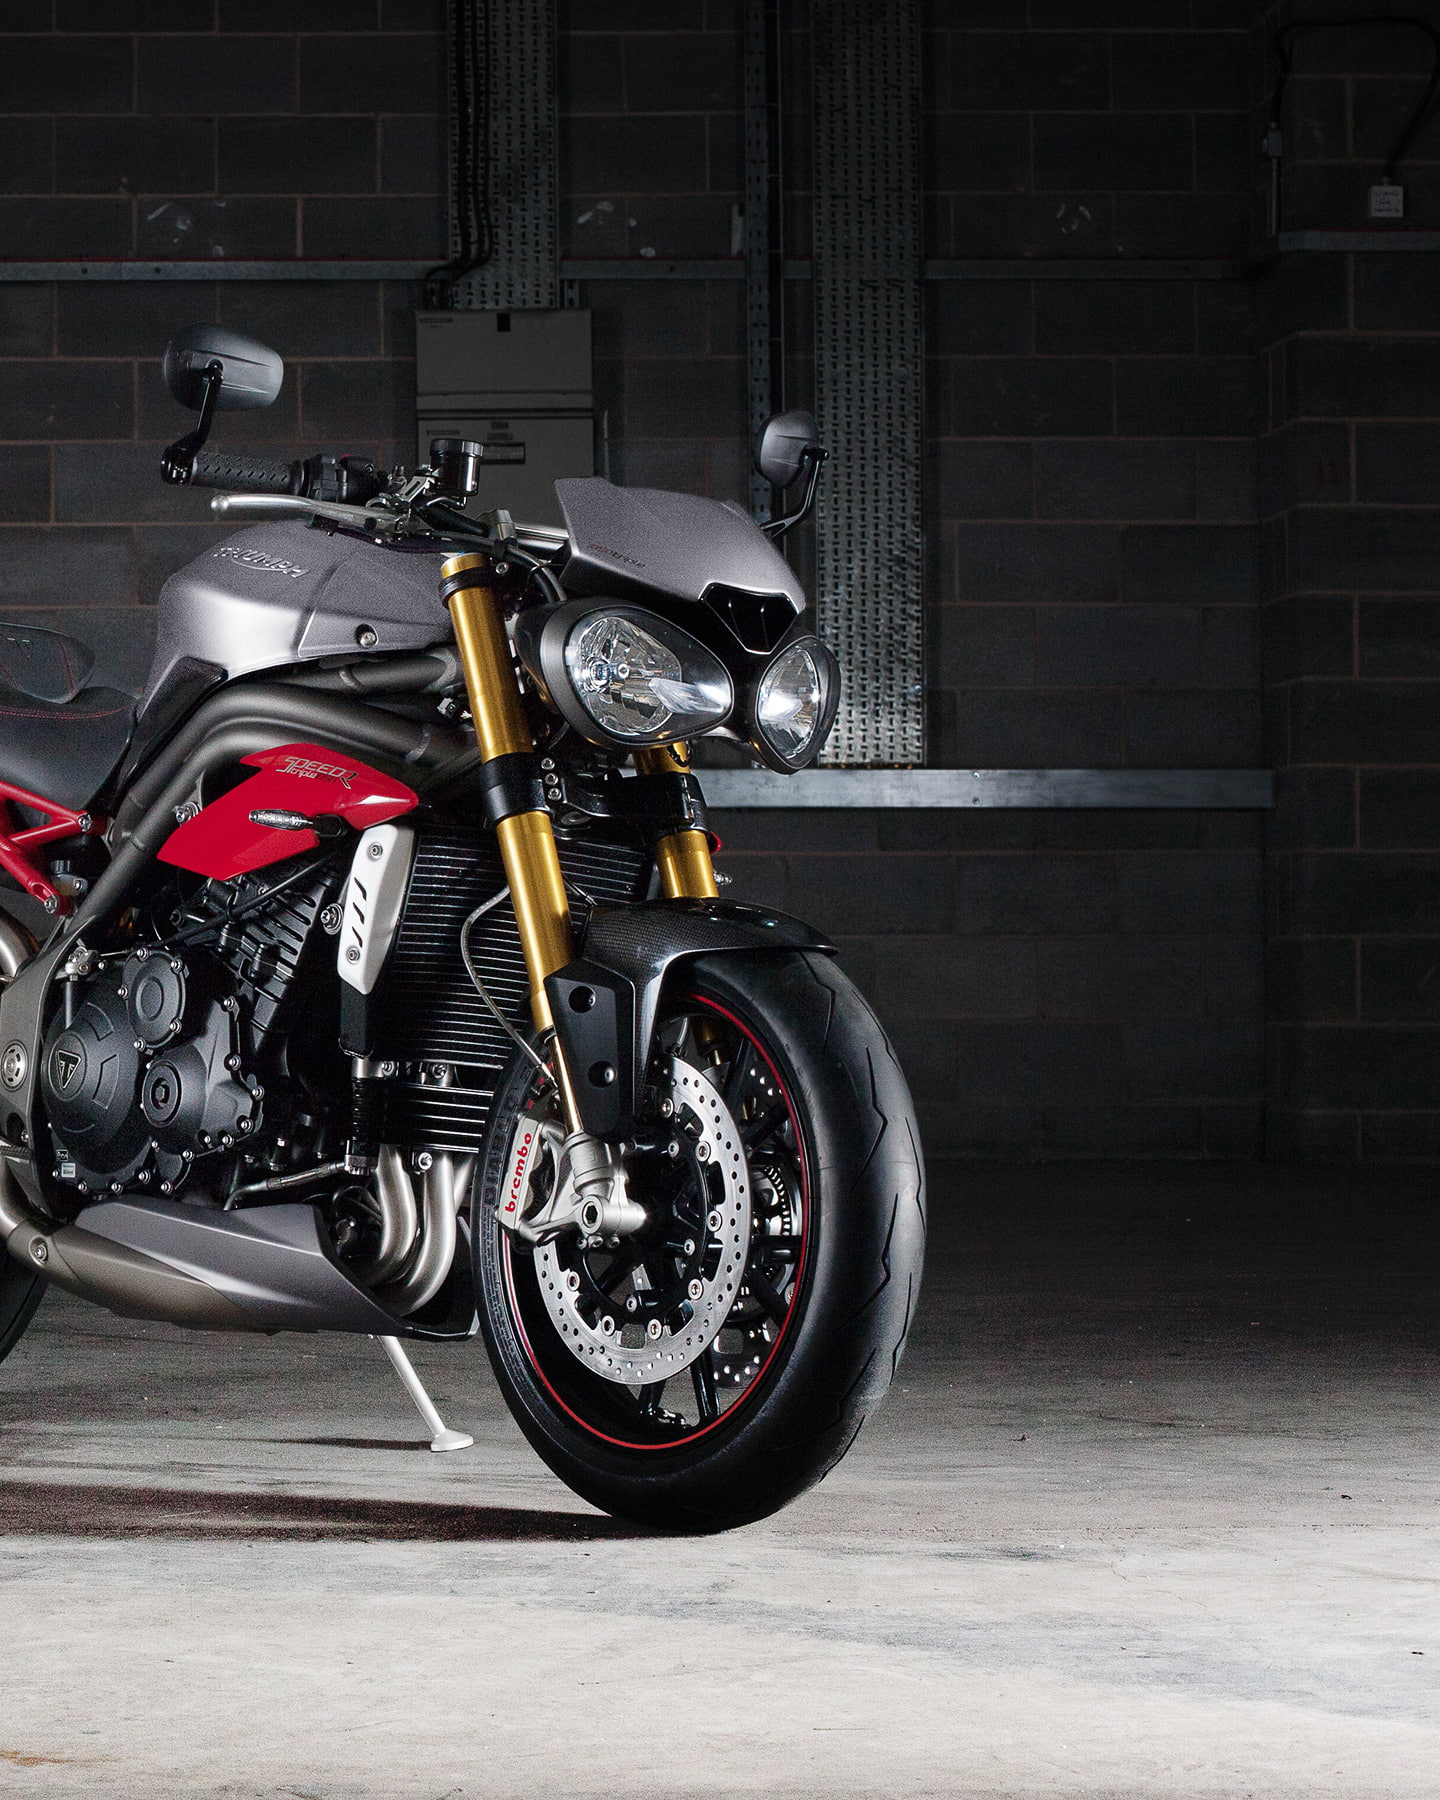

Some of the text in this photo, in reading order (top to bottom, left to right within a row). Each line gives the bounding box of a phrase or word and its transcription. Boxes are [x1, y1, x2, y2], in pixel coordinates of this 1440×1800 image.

[213, 546, 309, 578] TRIUMPH
[275, 756, 348, 778] SPEED
[504, 1132, 532, 1213] brembo
